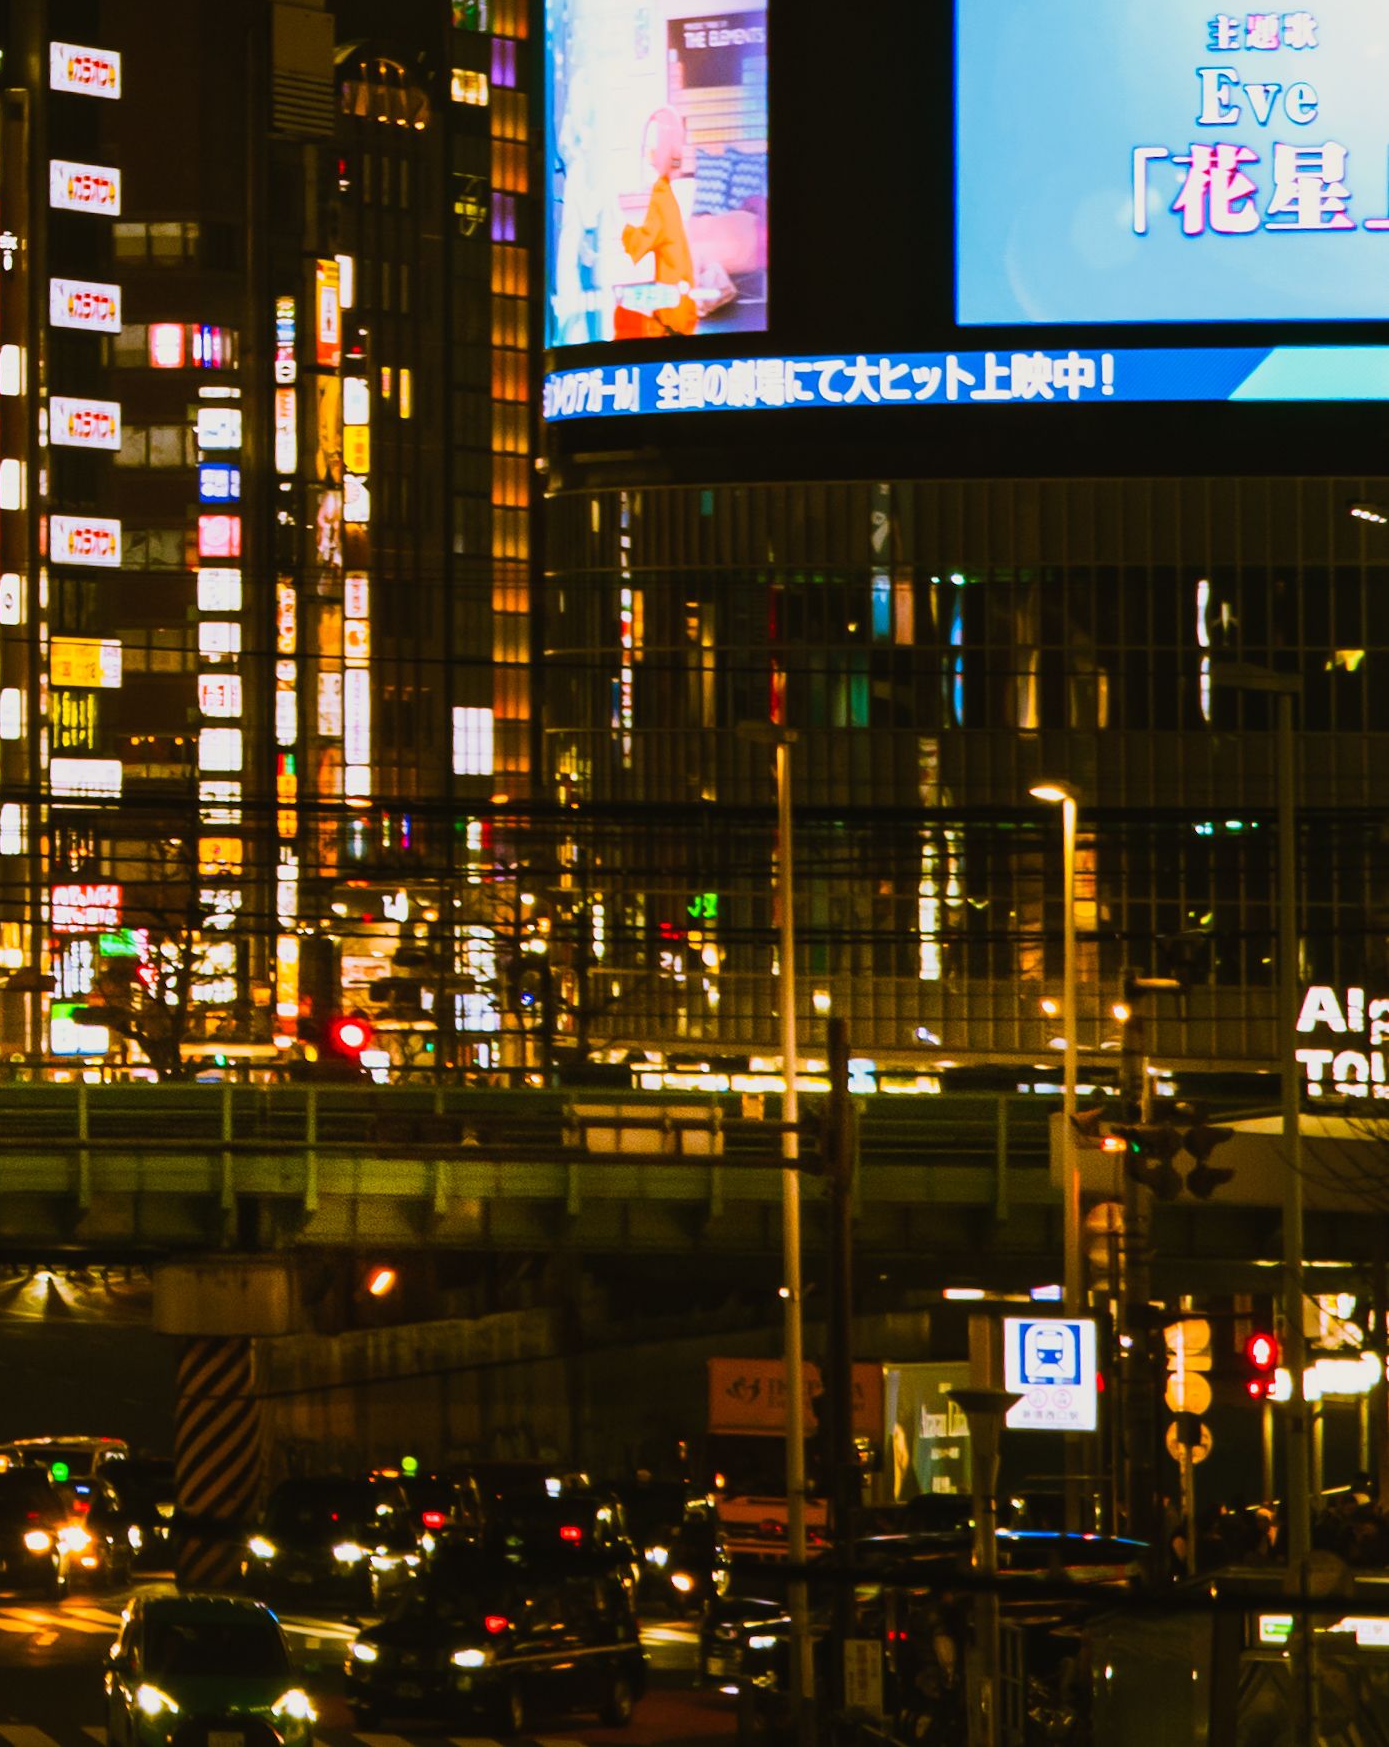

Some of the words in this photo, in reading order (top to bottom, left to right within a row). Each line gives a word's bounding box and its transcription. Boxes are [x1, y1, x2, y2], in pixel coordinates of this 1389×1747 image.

[1206, 12, 1319, 52] 主題歌
[1196, 67, 1319, 126] Eve
